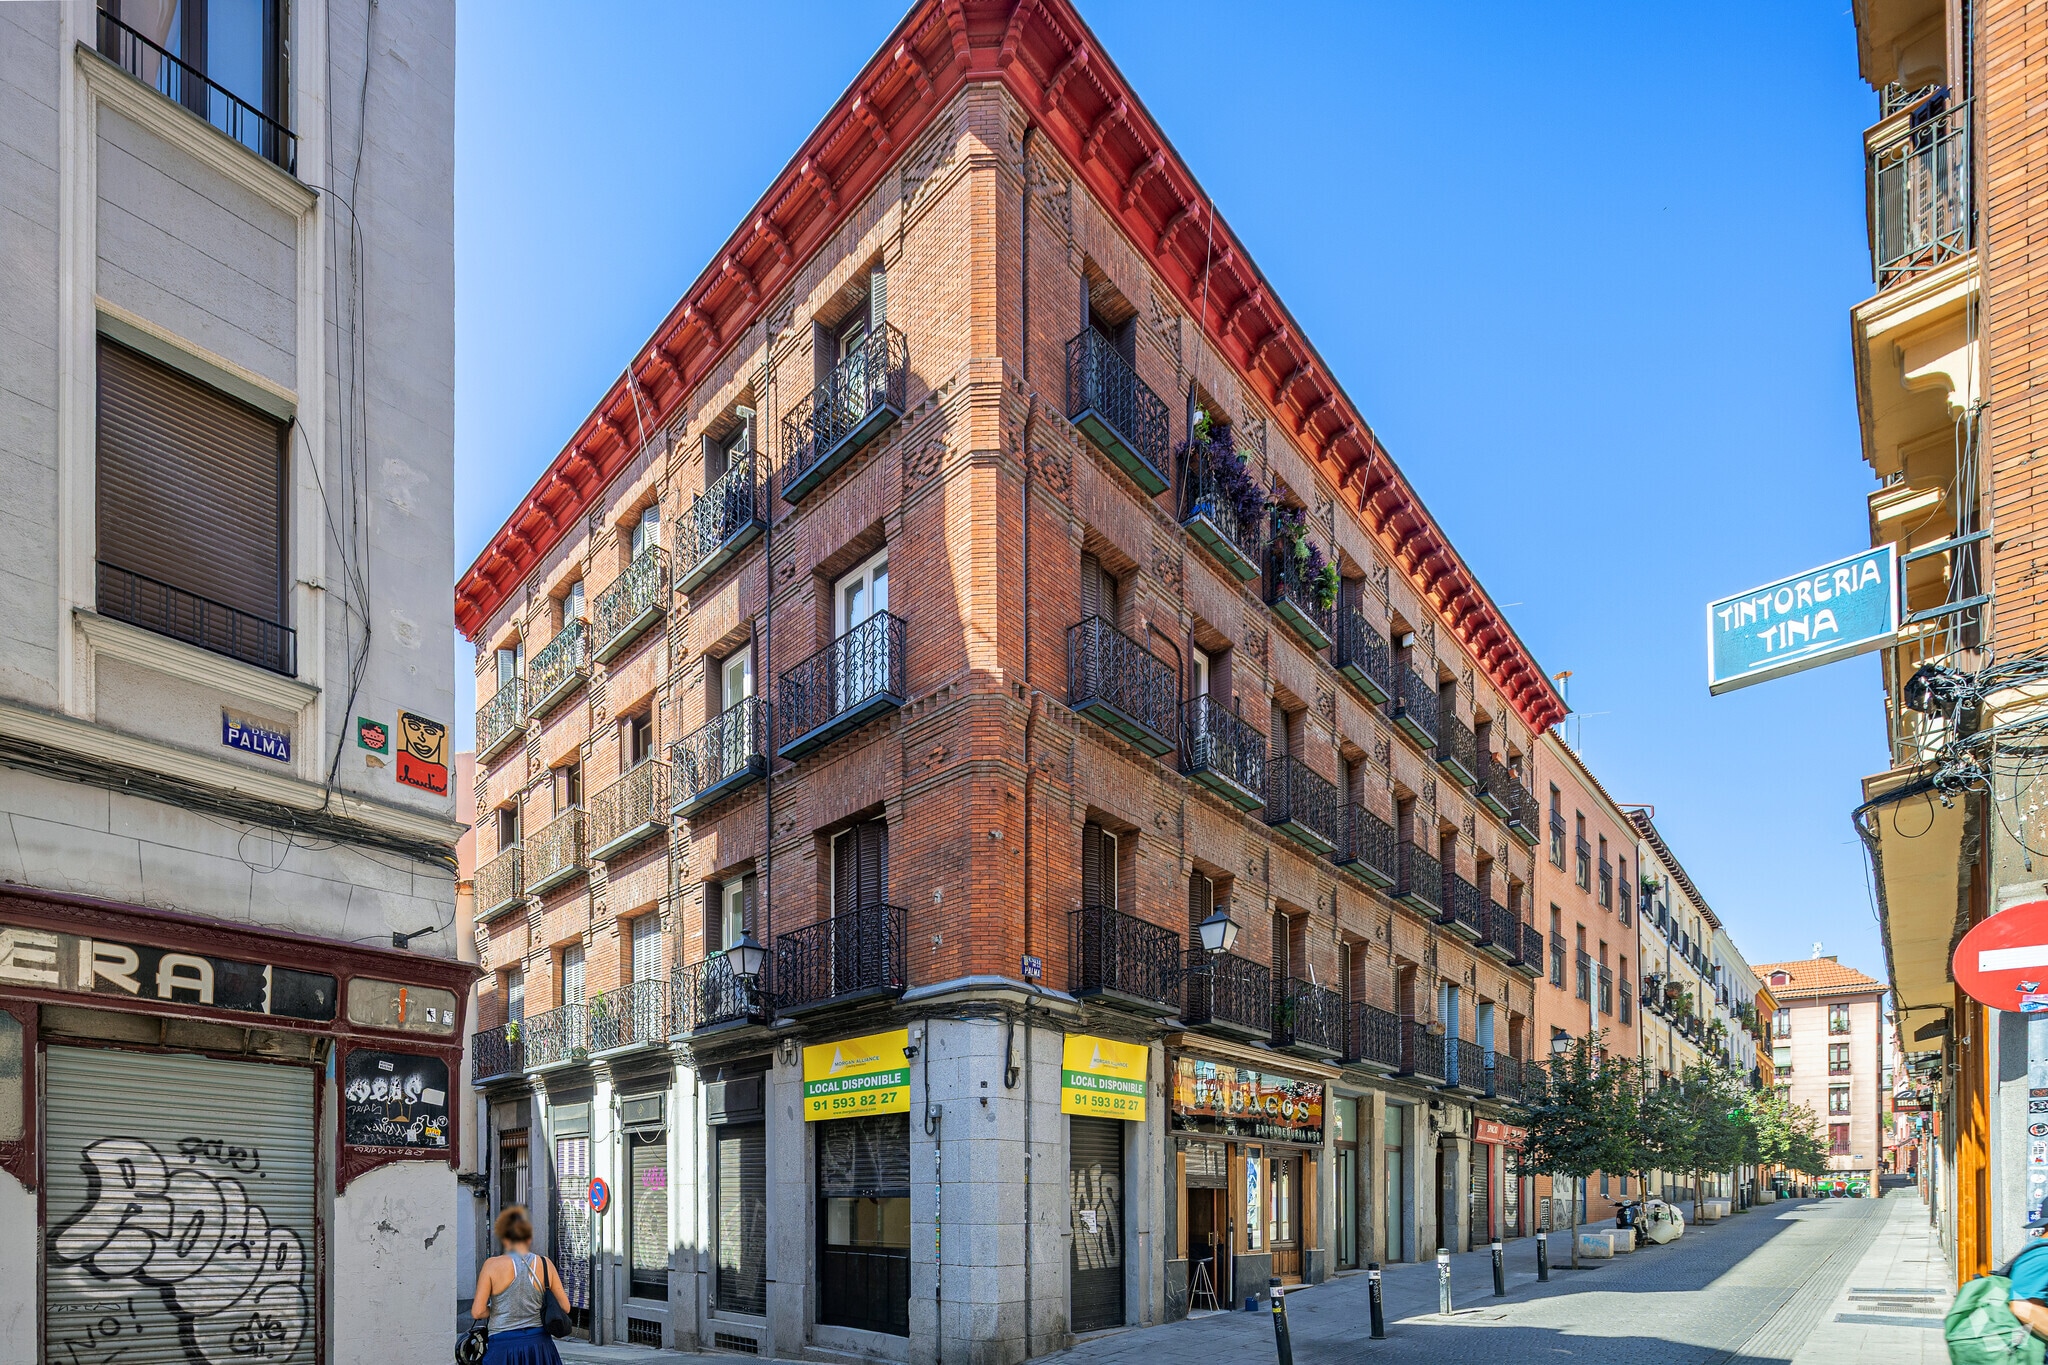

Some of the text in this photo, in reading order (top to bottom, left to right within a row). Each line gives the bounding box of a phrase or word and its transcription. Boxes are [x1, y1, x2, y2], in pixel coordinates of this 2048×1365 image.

[1717, 559, 1881, 632] TINTORERIA
[1757, 608, 1839, 653] TINA
[228, 728, 287, 759] PALMA
[252, 728, 282, 742] DE LA
[809, 1073, 902, 1095] LOCAL DISPONIBLE
[1071, 1074, 1143, 1094] LOCAL DISPONIBLE
[813, 1092, 898, 1111] 91 593 82 27
[1074, 1093, 1139, 1111] 91 593 82 27
